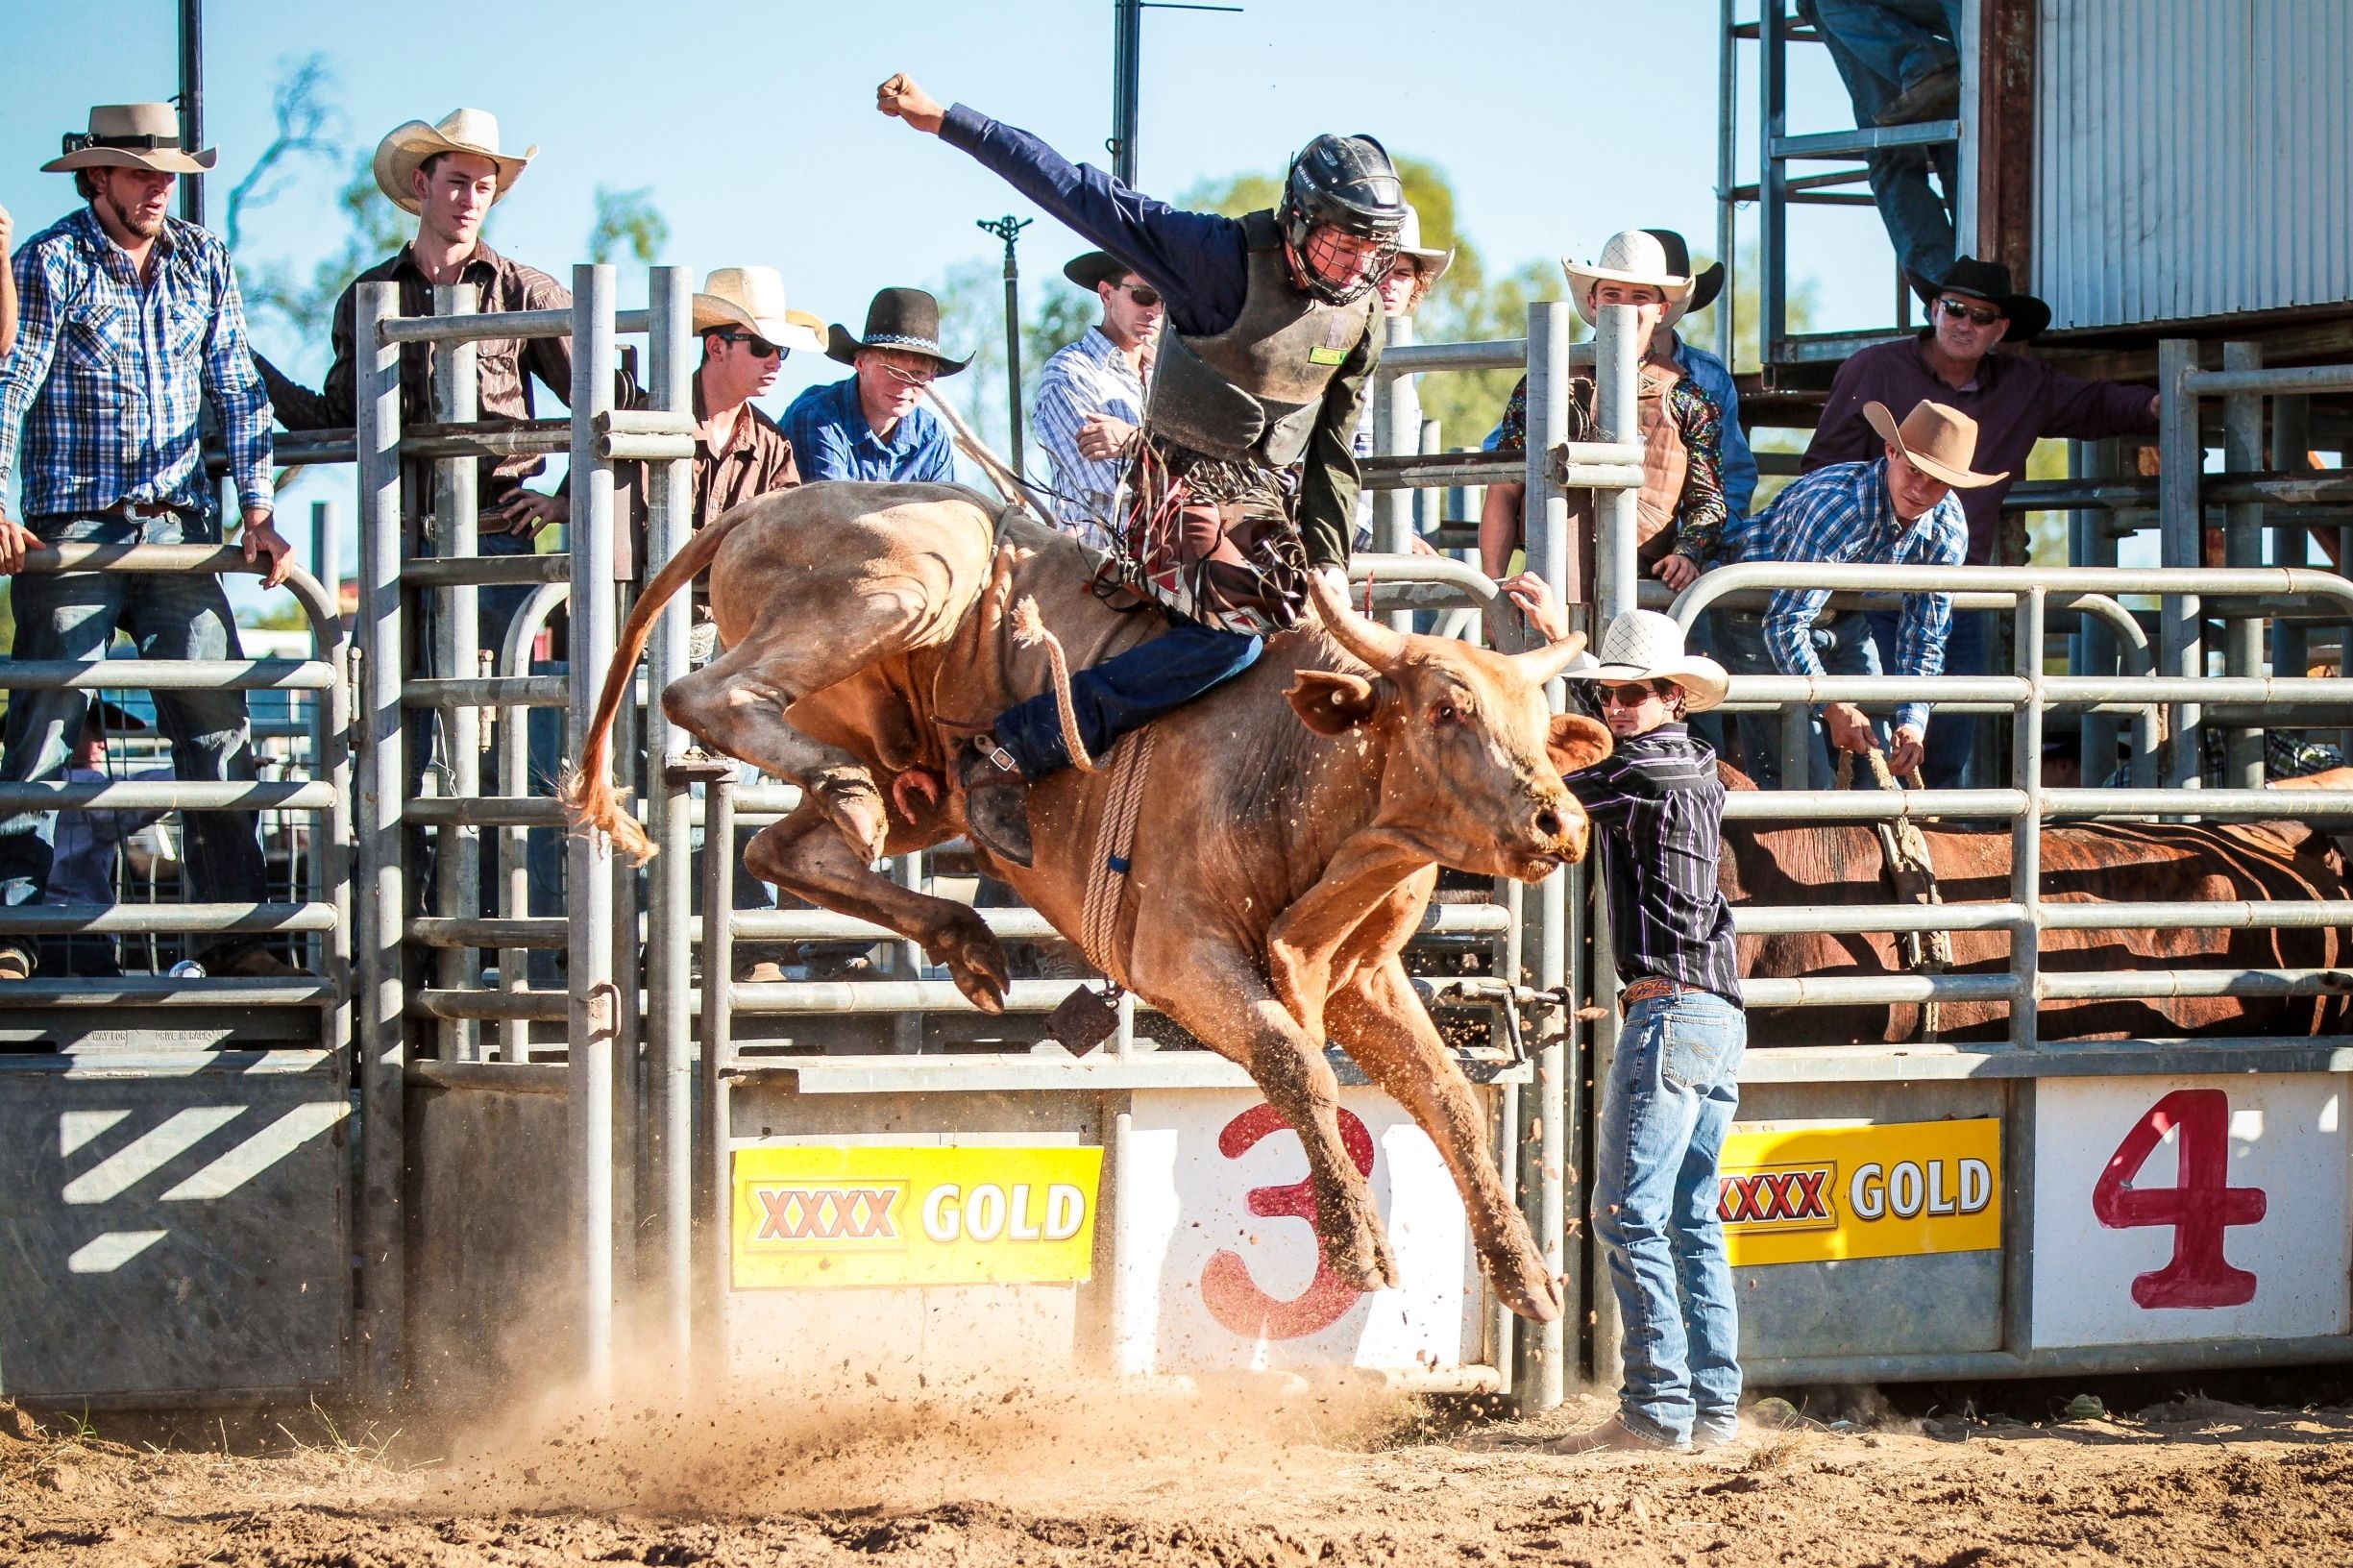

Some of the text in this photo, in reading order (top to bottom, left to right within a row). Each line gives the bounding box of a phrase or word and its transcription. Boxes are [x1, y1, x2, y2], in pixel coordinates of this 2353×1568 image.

[110, 1031, 127, 1041] FOR
[156, 1031, 177, 1041] DRIVE
[180, 1031, 186, 1041] IN
[758, 1183, 1086, 1242] XXXX GOLD
[1851, 1158, 1993, 1220] GOLD
[2092, 1089, 2267, 1310] 4
[1201, 1102, 1375, 1340] 3
